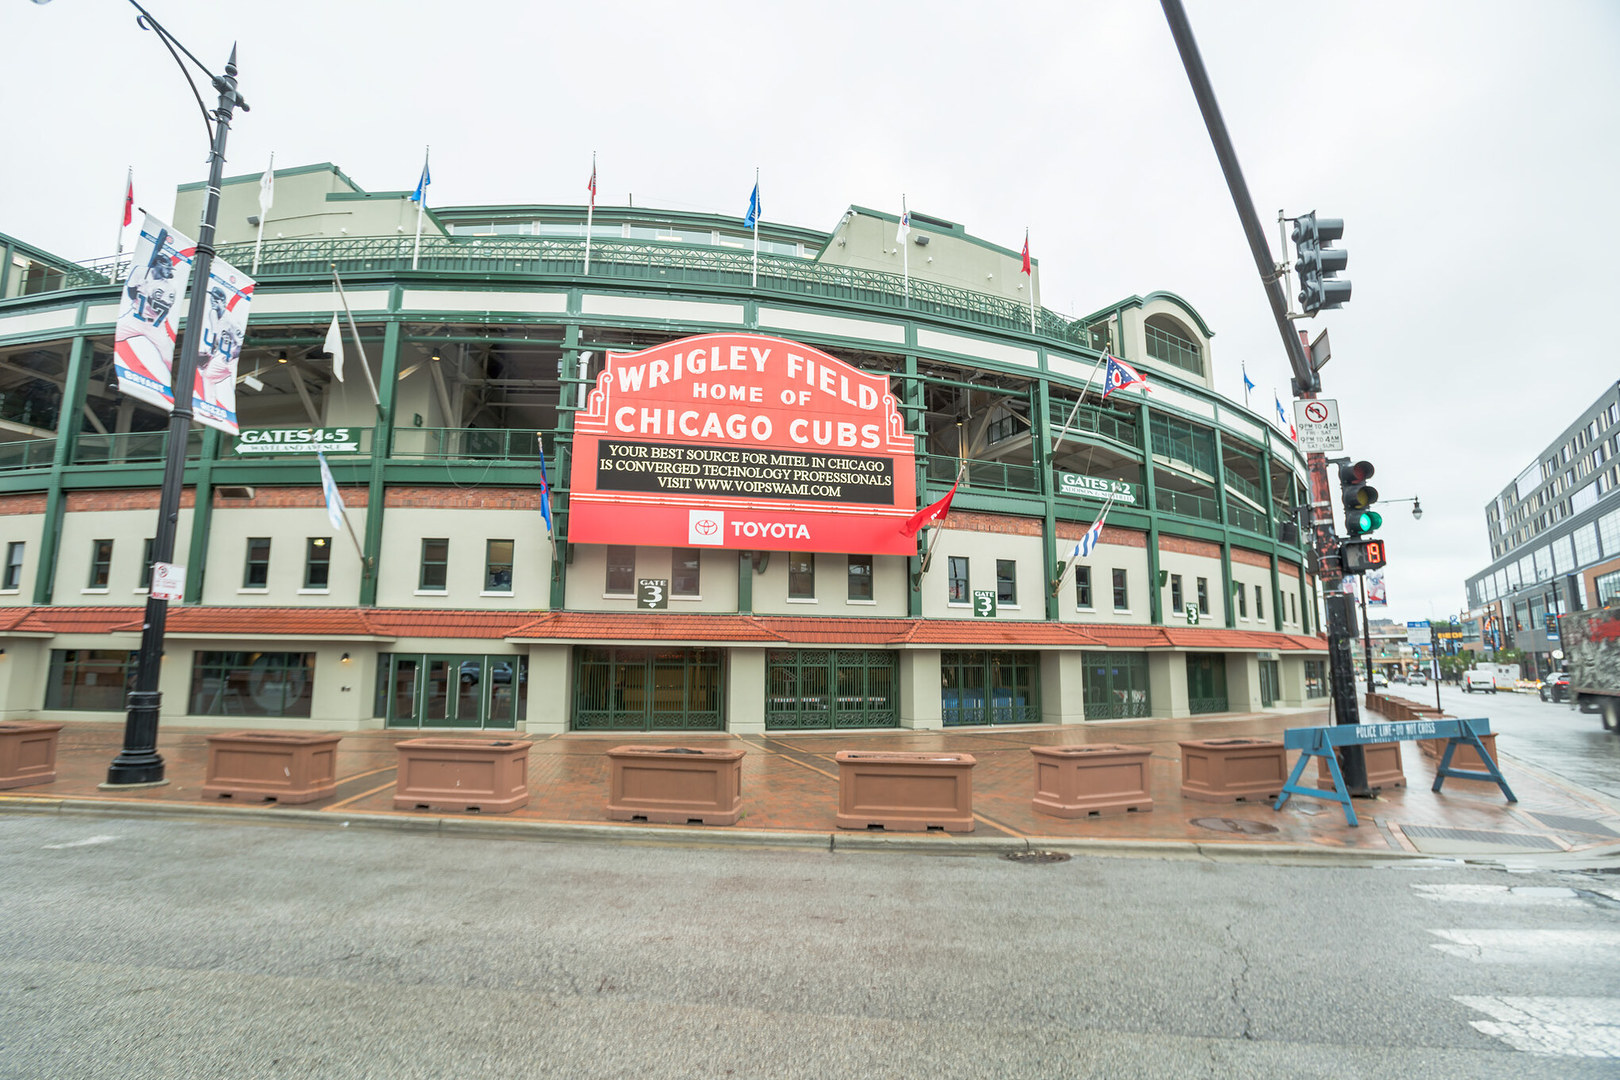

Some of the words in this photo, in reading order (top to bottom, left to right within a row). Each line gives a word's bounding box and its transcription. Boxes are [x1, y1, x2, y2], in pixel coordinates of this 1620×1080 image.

[132, 293, 169, 328] 17
[203, 328, 233, 362] 44
[617, 346, 771, 393] WRIGLEY
[787, 352, 879, 410] FIELD
[692, 382, 763, 403] HOME
[780, 389, 812, 407] OF
[240, 430, 310, 443] GATES
[614, 406, 773, 441] CHICAGO
[789, 418, 881, 449] CUBS
[609, 444, 649, 458] YOUR
[651, 447, 684, 460] BEST
[686, 450, 740, 463] SOURCE
[742, 452, 768, 465] FOR
[770, 454, 810, 467] MITEL
[812, 457, 826, 468] IN
[828, 459, 885, 472] CHICAGO
[600, 458, 613, 471] IS
[615, 460, 701, 475] CONVERGED
[702, 464, 792, 480] TECHNOLOGY
[793, 470, 892, 486] PROFESSIONALS
[1063, 474, 1108, 490] GATES
[657, 476, 692, 489] VISIT
[694, 478, 842, 497] WWW.VOIPSWAMI.COM
[731, 521, 811, 539] TOYOTA
[1366, 542, 1380, 563] 19
[642, 585, 663, 602] 3
[977, 596, 992, 612] 3
[1188, 607, 1197, 621] 3
[1355, 724, 1377, 738] POLICE
[1405, 722, 1417, 735] NOT
[1418, 722, 1436, 735] CROSS
